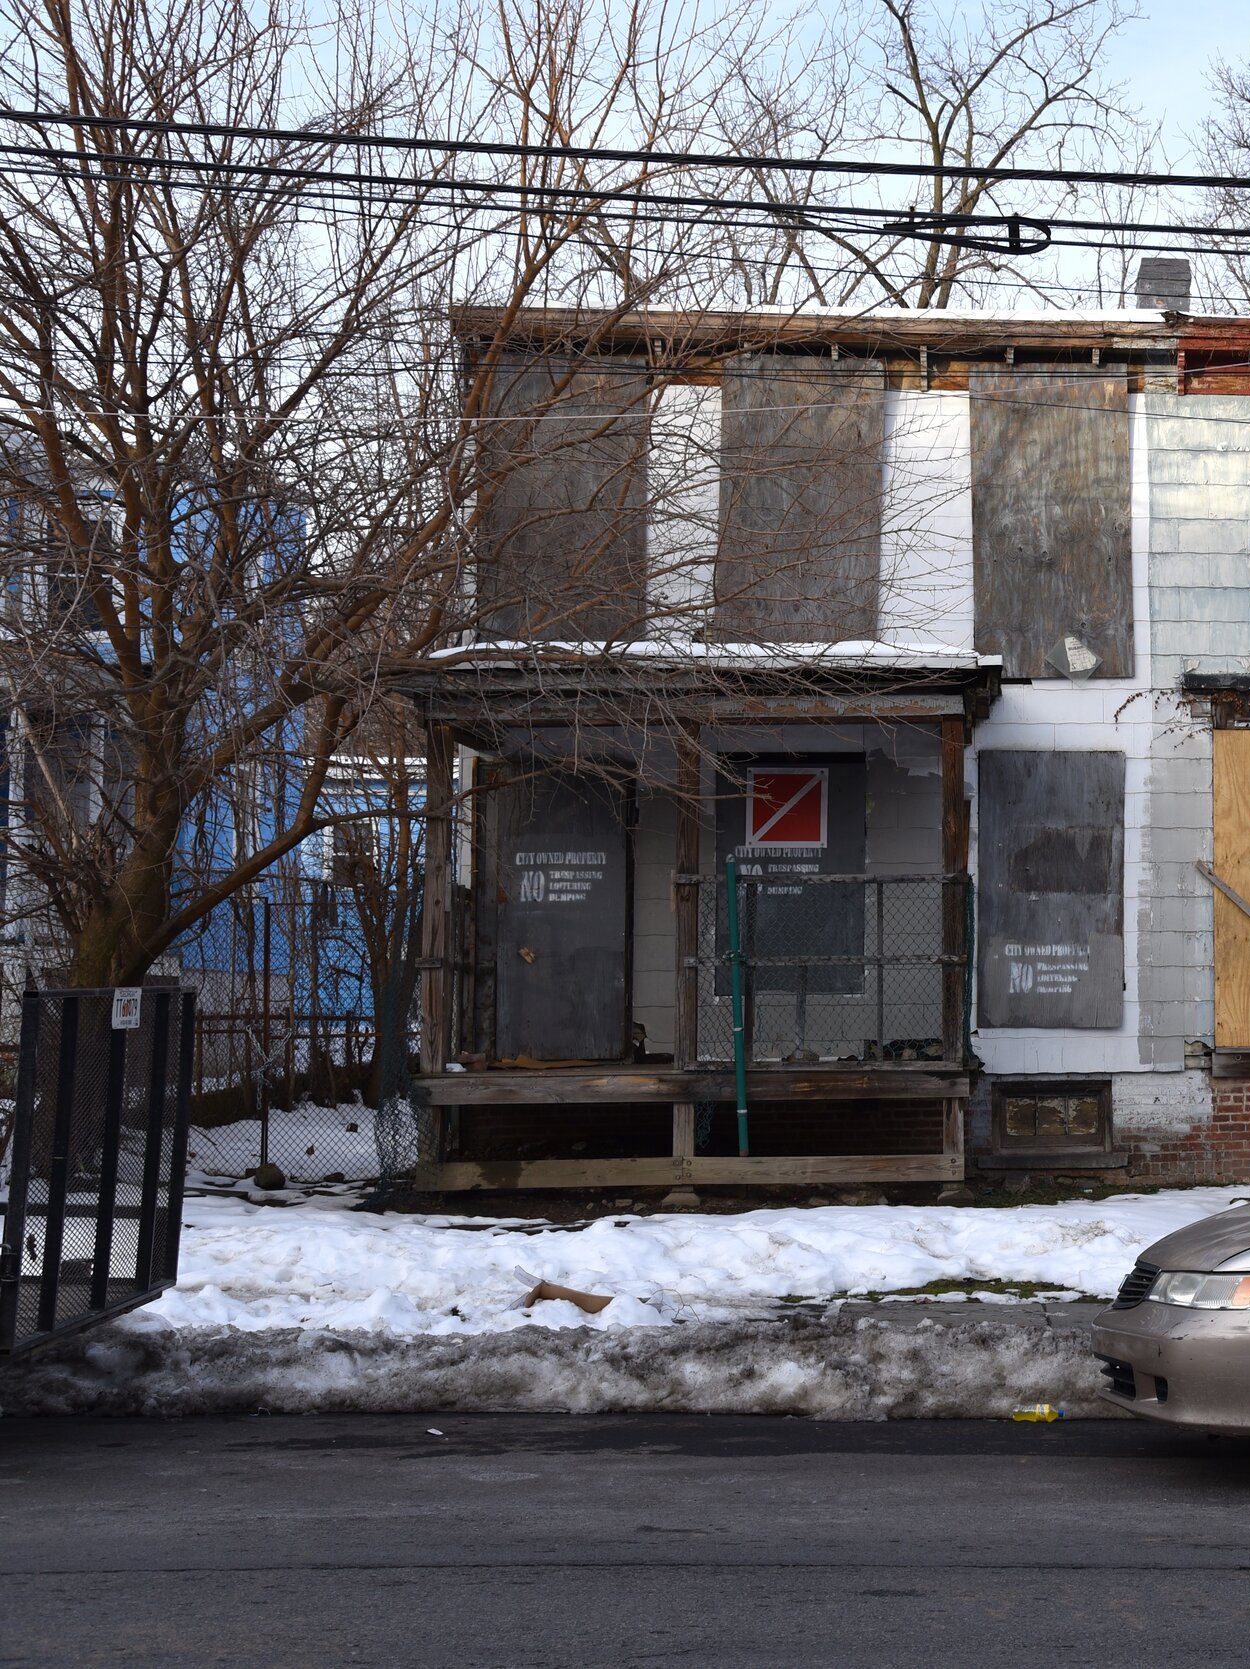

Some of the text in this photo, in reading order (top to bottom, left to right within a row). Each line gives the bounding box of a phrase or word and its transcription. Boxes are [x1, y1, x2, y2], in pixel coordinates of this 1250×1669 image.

[515, 852, 607, 866] CITY OWNED PROPERTY
[768, 864, 819, 873] TRESPASSING
[549, 871, 603, 880] TRESPASSING
[520, 871, 545, 903] NO
[549, 882, 592, 891] LOITERING
[767, 886, 803, 896] DUMPING
[549, 893, 587, 902] DUMPING
[1005, 944, 1022, 957] CITY
[1009, 962, 1034, 994] NO
